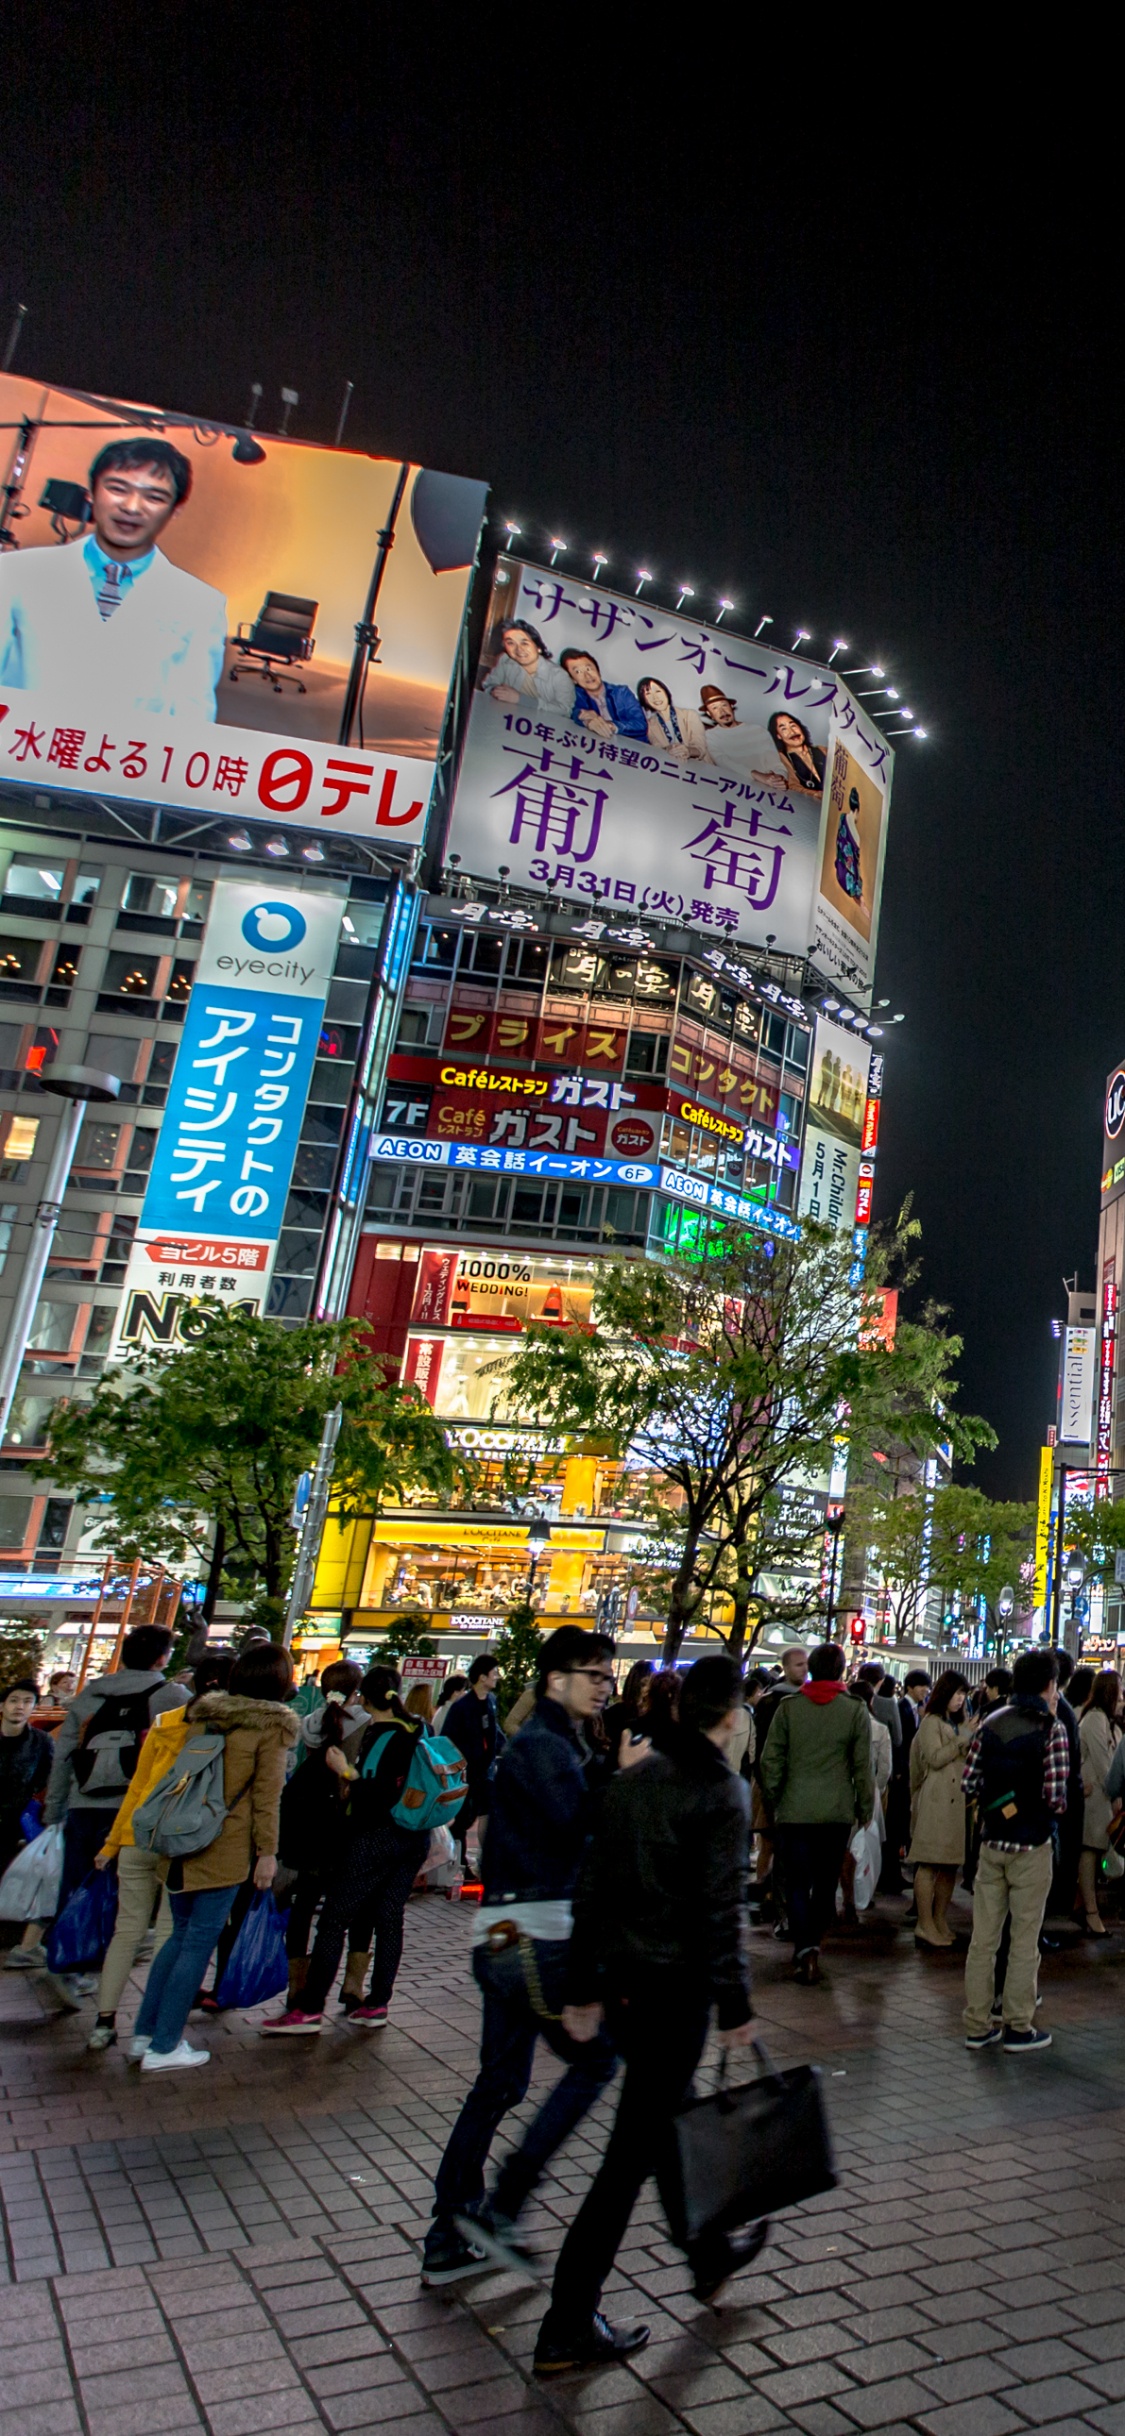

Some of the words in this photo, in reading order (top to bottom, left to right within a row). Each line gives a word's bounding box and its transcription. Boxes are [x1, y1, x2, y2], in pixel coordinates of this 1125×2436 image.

[522, 578, 888, 785] サザンオールスターズ
[8, 721, 250, 797] 水曜よる10時
[503, 714, 796, 814] 10年ぶり待望のニューアルバム
[216, 954, 315, 985] eyecity
[450, 1013, 620, 1060] プライス
[551, 1076, 637, 1111] ガスト
[671, 1044, 775, 1113] コンタクト
[170, 1006, 257, 1213] アイシティ
[229, 1014, 304, 1218] コンタクトの
[386, 1100, 429, 1126] 7F
[438, 1106, 486, 1125] Café
[437, 1124, 484, 1138] レストラン
[488, 1108, 597, 1151] ガスト
[616, 1133, 651, 1147] ガスト
[378, 1137, 443, 1161] AEON
[455, 1145, 612, 1179] 英会話イーオン
[744, 1128, 793, 1168] ガスト
[625, 1168, 646, 1180] 6F
[666, 1172, 704, 1200] AEON
[710, 1188, 801, 1240] 英会話イーオン
[160, 1242, 260, 1267] 当ビル5階
[159, 1271, 237, 1291] 利用者数
[457, 1260, 531, 1282] 1000%
[457, 1280, 528, 1297] WEDDING!
